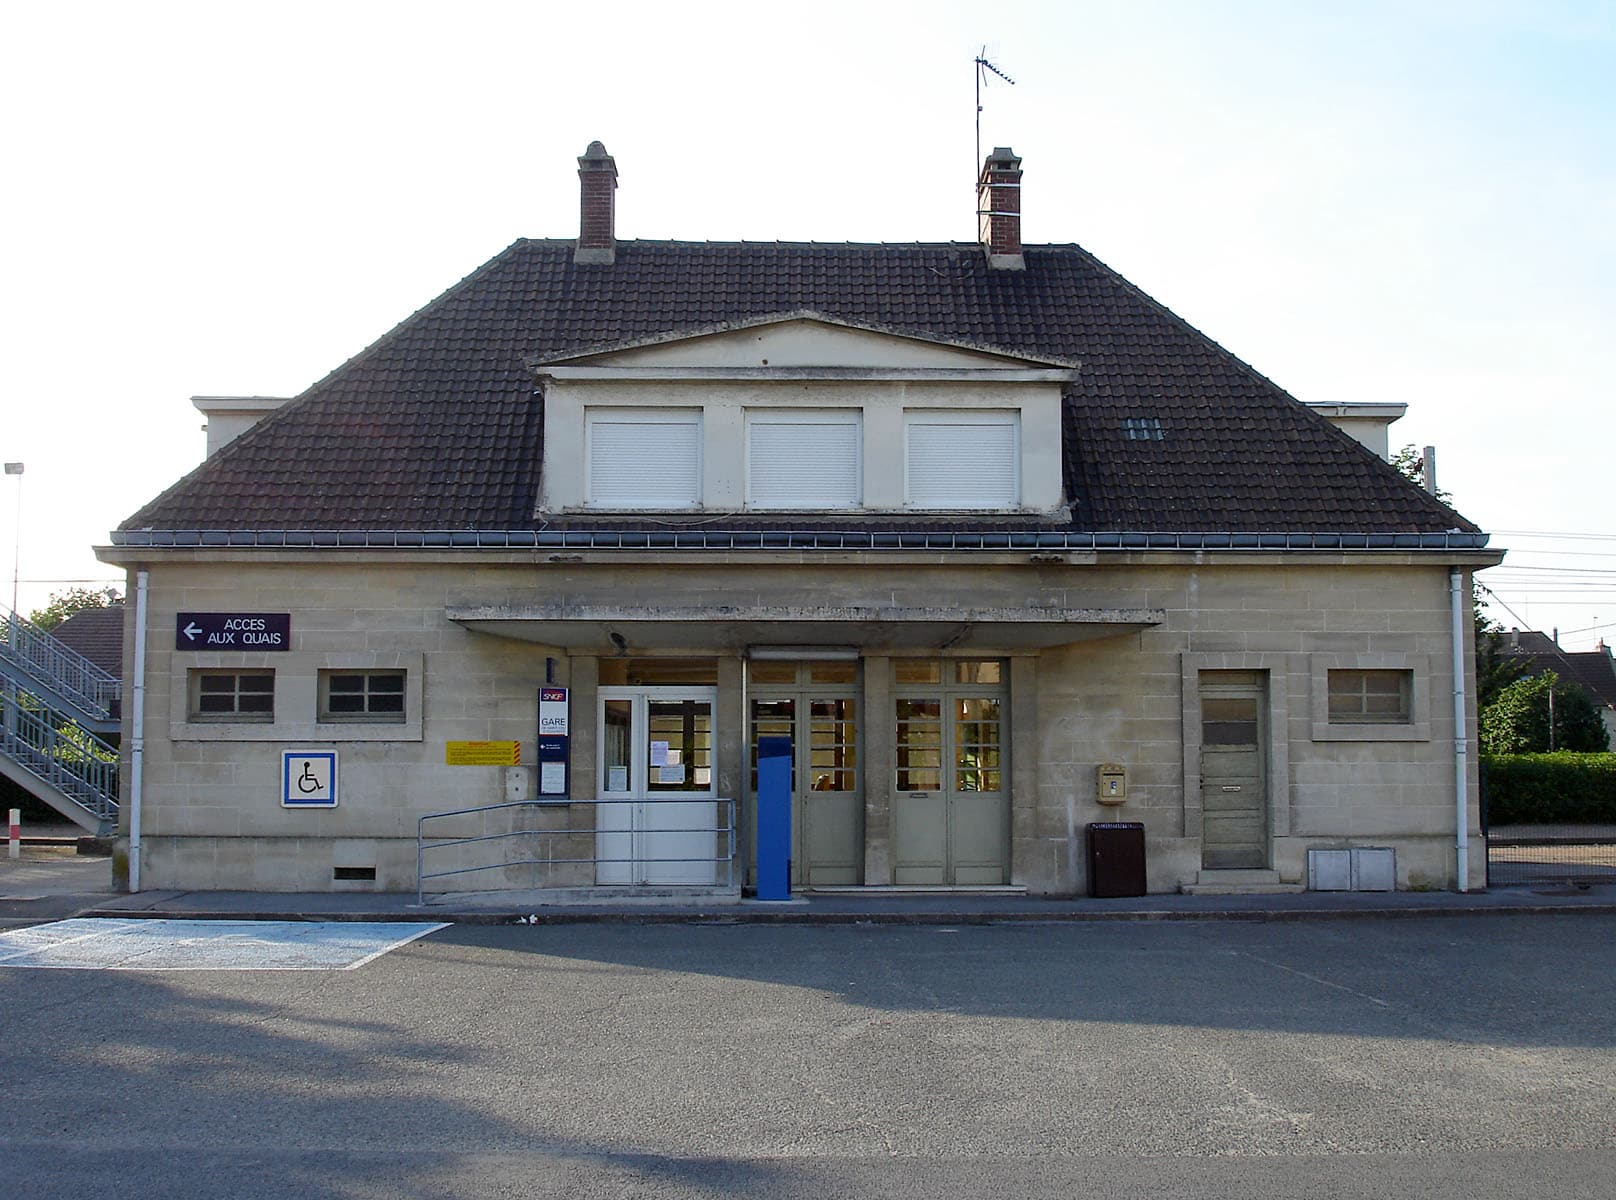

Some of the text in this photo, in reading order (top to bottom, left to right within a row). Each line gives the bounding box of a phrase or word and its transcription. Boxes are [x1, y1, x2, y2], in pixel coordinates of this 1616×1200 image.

[224, 618, 265, 631] ACCES
[207, 632, 281, 644] AUX QUAIS
[542, 693, 563, 701] SNCF
[541, 718, 565, 726] GARE
